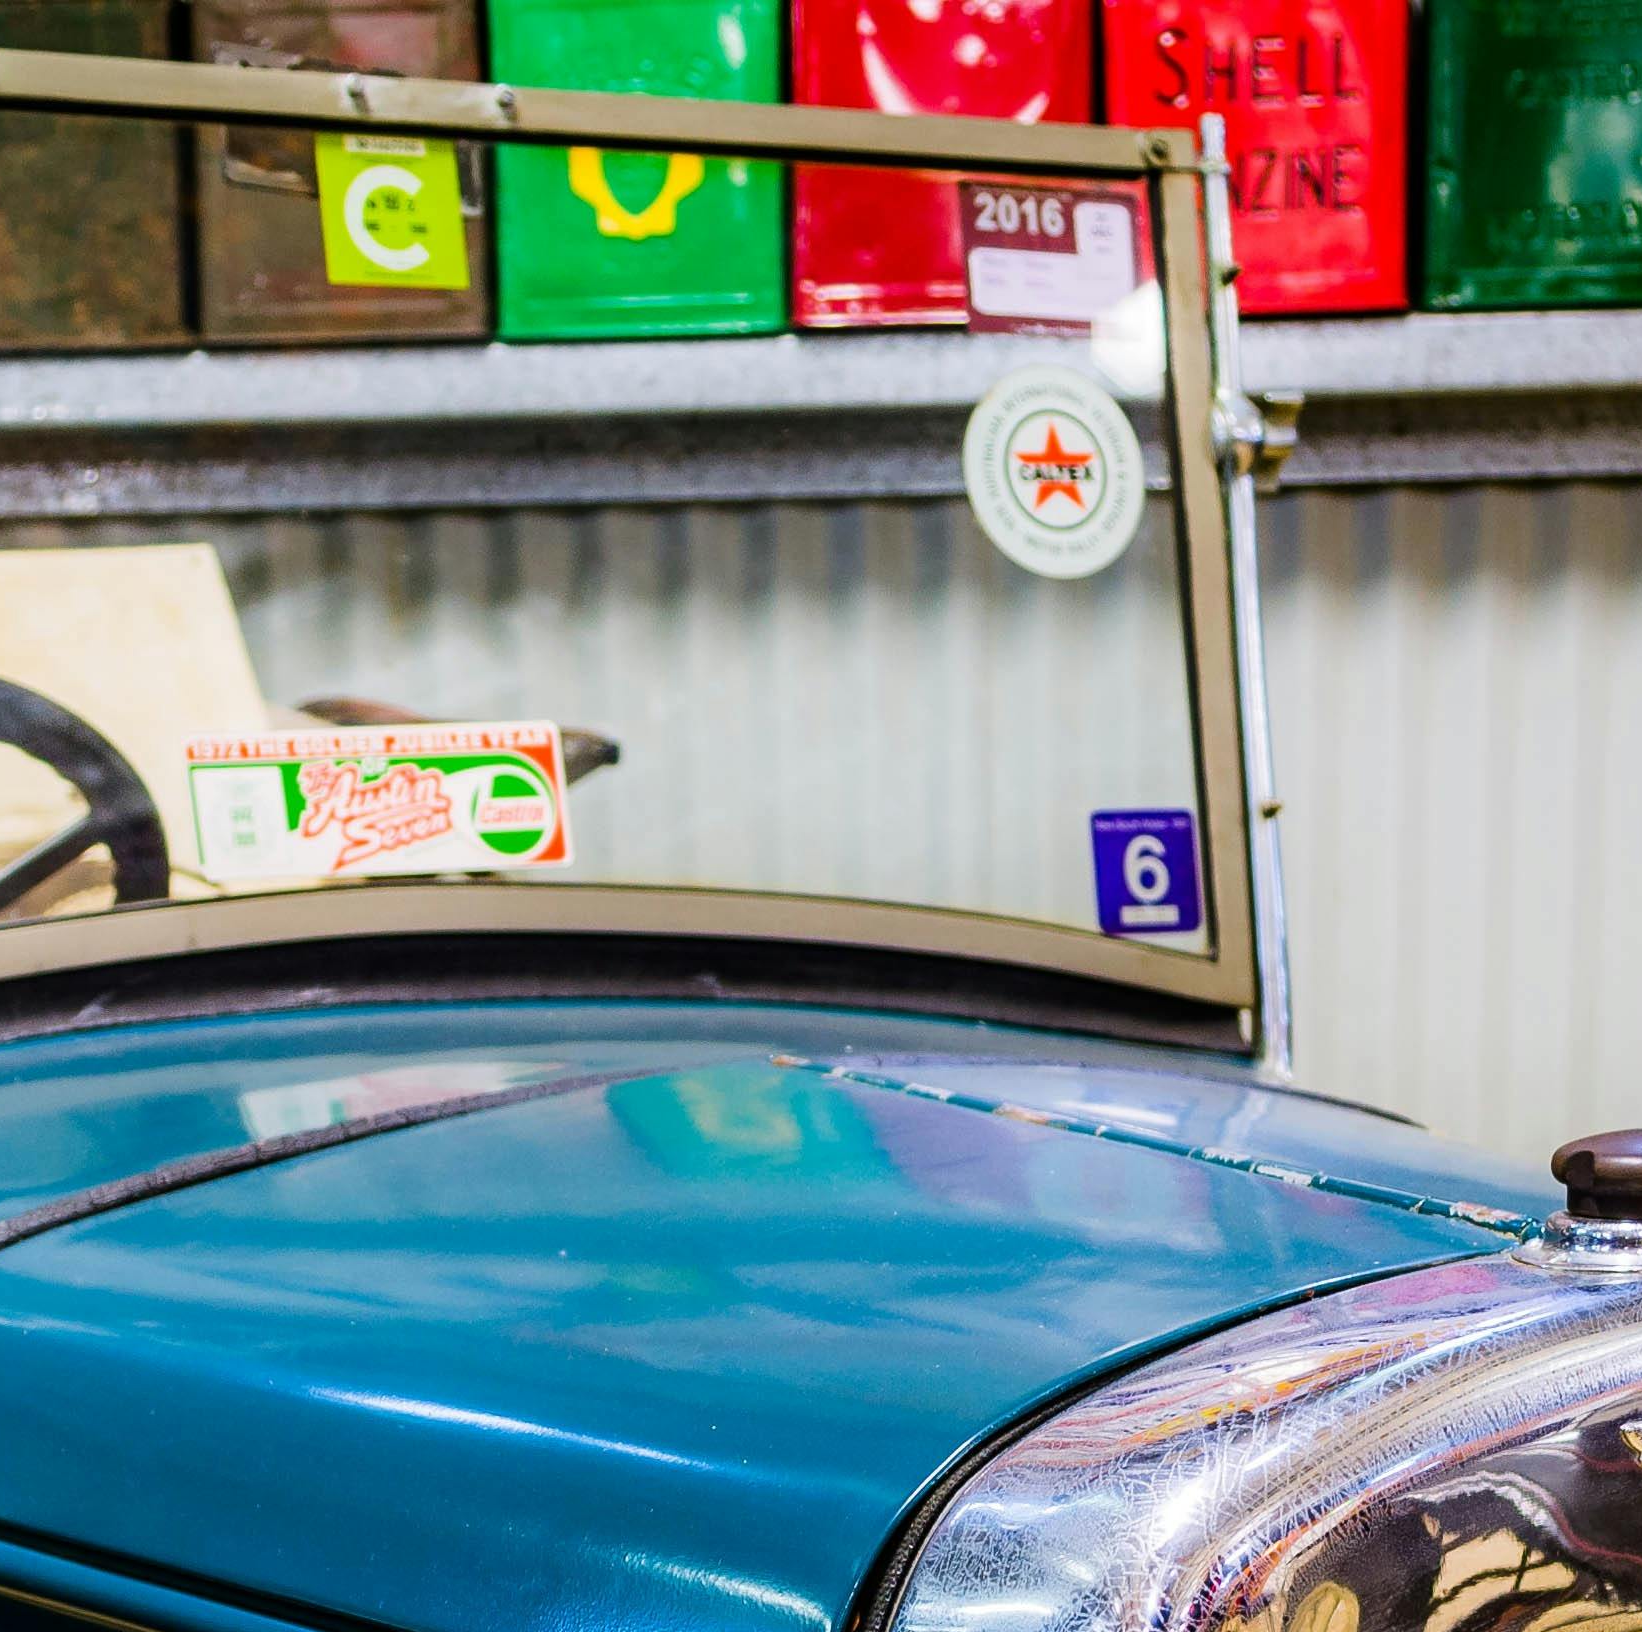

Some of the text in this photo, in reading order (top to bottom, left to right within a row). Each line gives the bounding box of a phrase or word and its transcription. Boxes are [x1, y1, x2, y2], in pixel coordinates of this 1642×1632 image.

[1154, 27, 1360, 110] SHELL
[343, 164, 430, 272] C
[972, 191, 1067, 238] 2016
[1018, 464, 1094, 482] CALTEX
[245, 738, 286, 757] THE
[295, 735, 383, 754] GOLDEN
[394, 732, 481, 752] JUBILEE
[490, 729, 548, 748] YEAR
[480, 801, 544, 824] Castrol
[334, 815, 453, 872] Seven
[1123, 834, 1170, 904] 6
